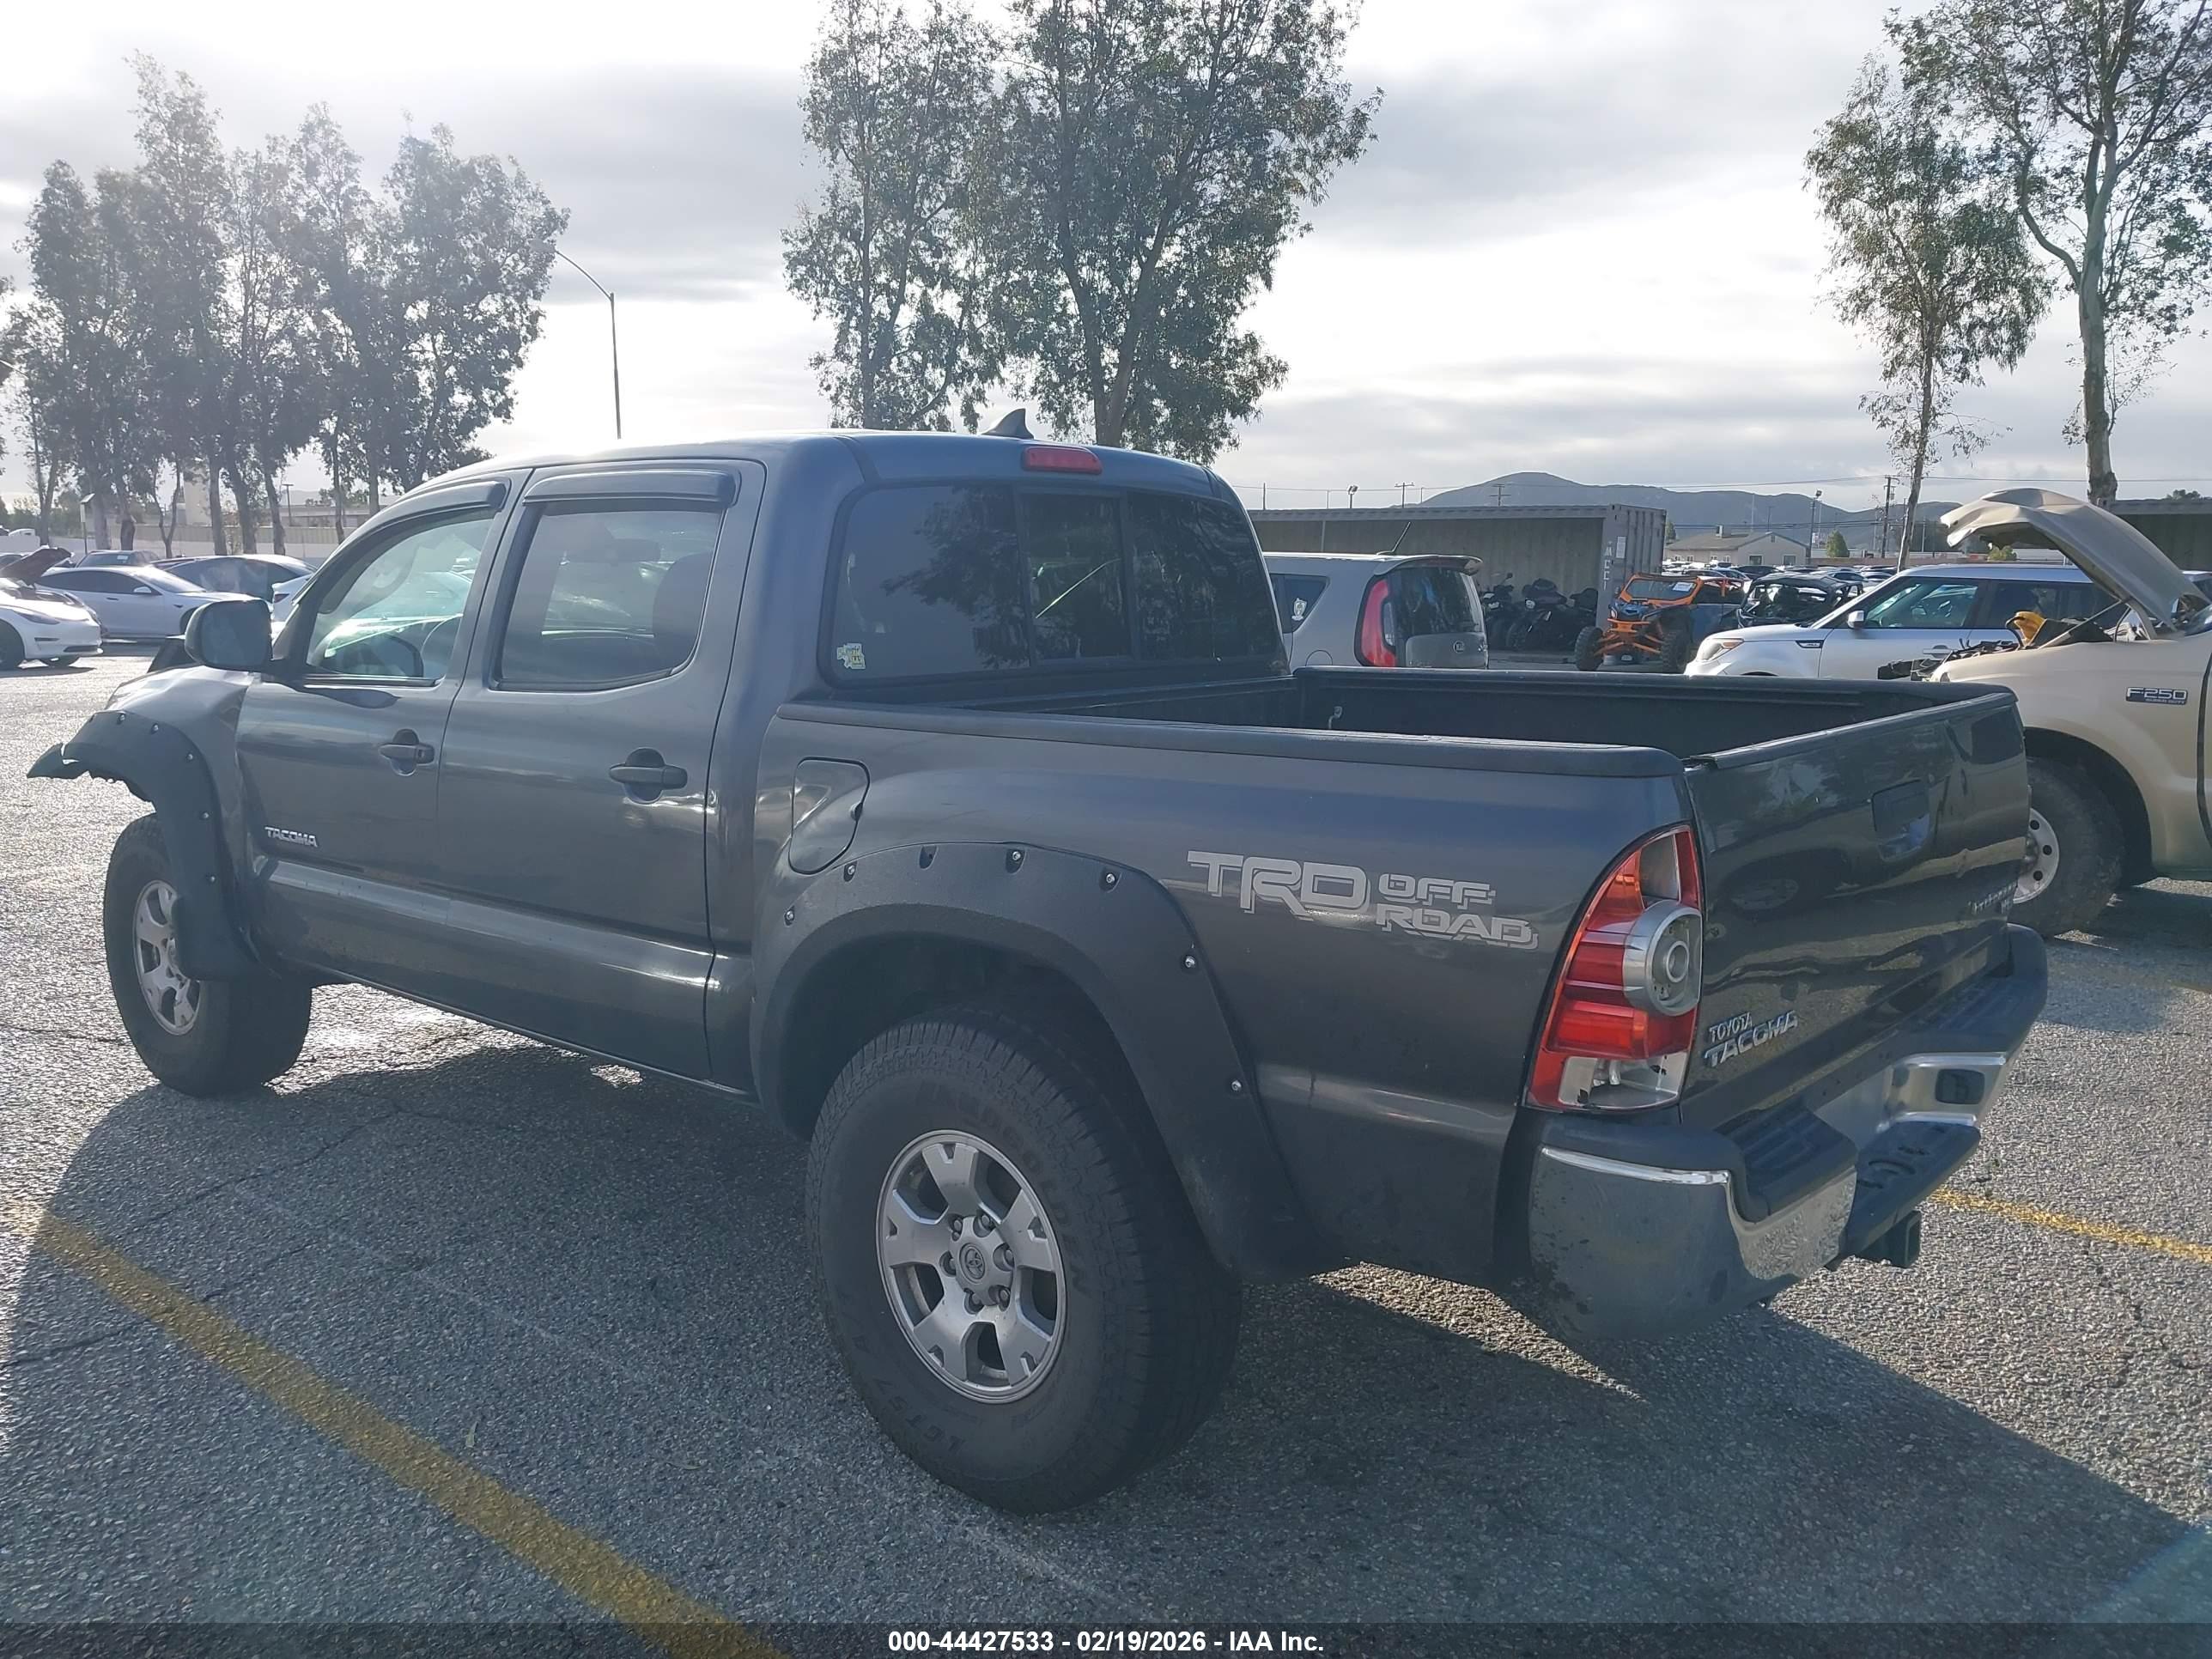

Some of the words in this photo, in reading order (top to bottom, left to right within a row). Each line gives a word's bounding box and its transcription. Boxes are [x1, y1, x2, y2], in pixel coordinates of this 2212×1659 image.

[264, 826, 318, 848] TACOMA
[1188, 850, 1371, 921] TRD
[1378, 873, 1496, 908] OFF
[1376, 903, 1538, 950] ROAD
[1705, 1010, 1799, 1067] TACOMA
[1709, 1012, 1753, 1043] TOYOTA
